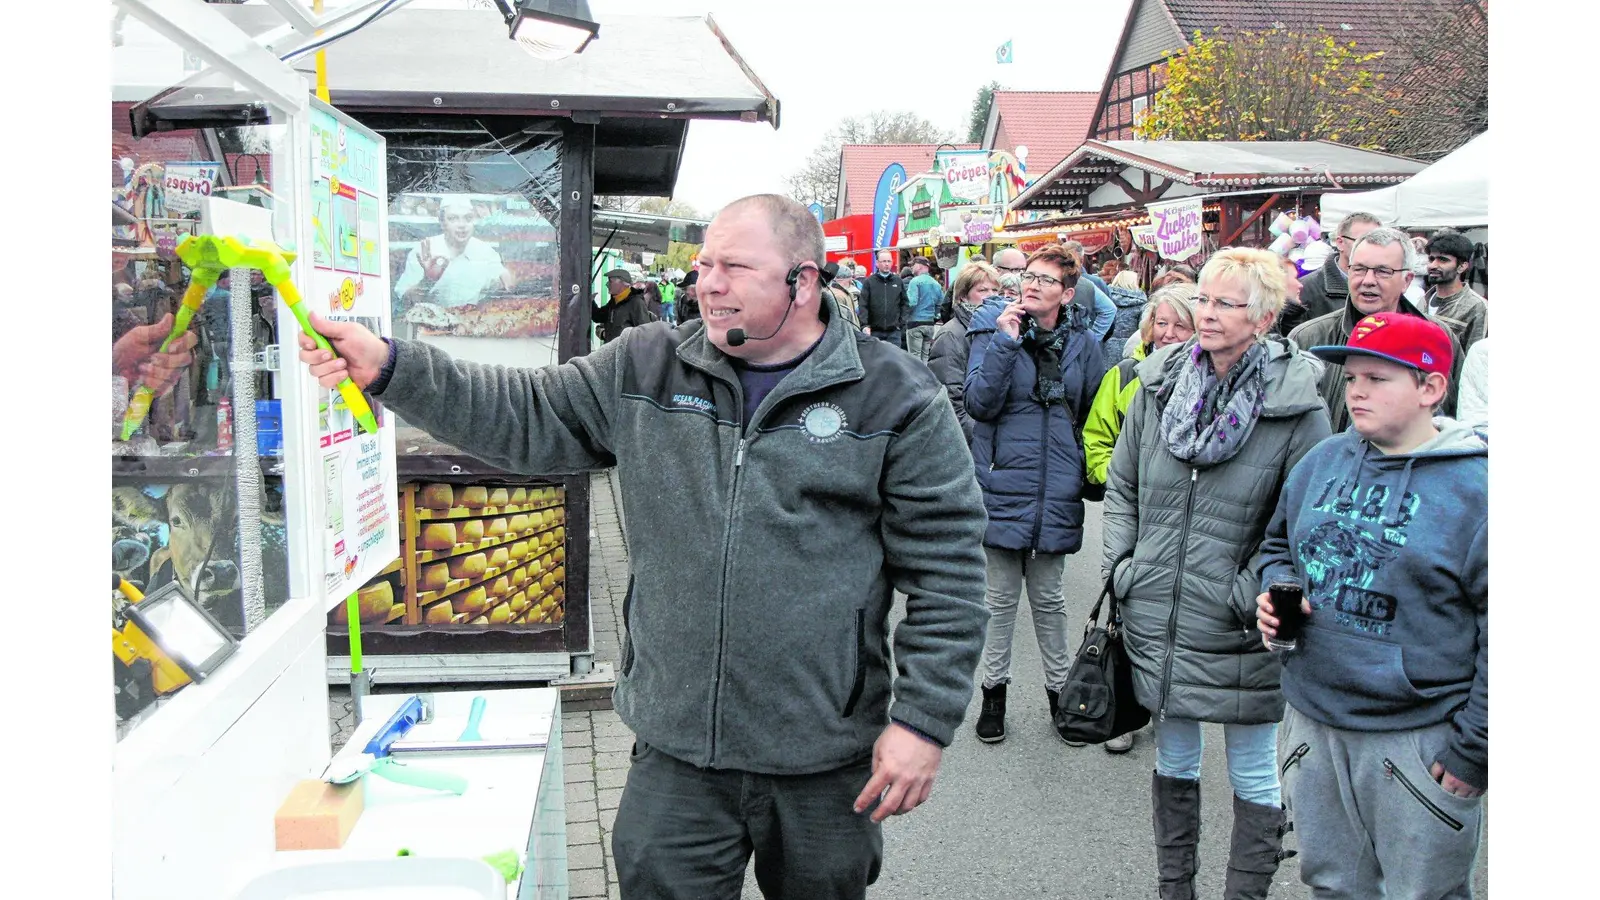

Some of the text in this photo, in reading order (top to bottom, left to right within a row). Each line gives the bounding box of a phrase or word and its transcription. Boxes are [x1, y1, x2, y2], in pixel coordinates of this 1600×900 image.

[947, 165, 987, 184] Crêpes
[1163, 203, 1199, 216] Köstliche
[1162, 228, 1199, 256] watte
[672, 394, 694, 402] OCEAN
